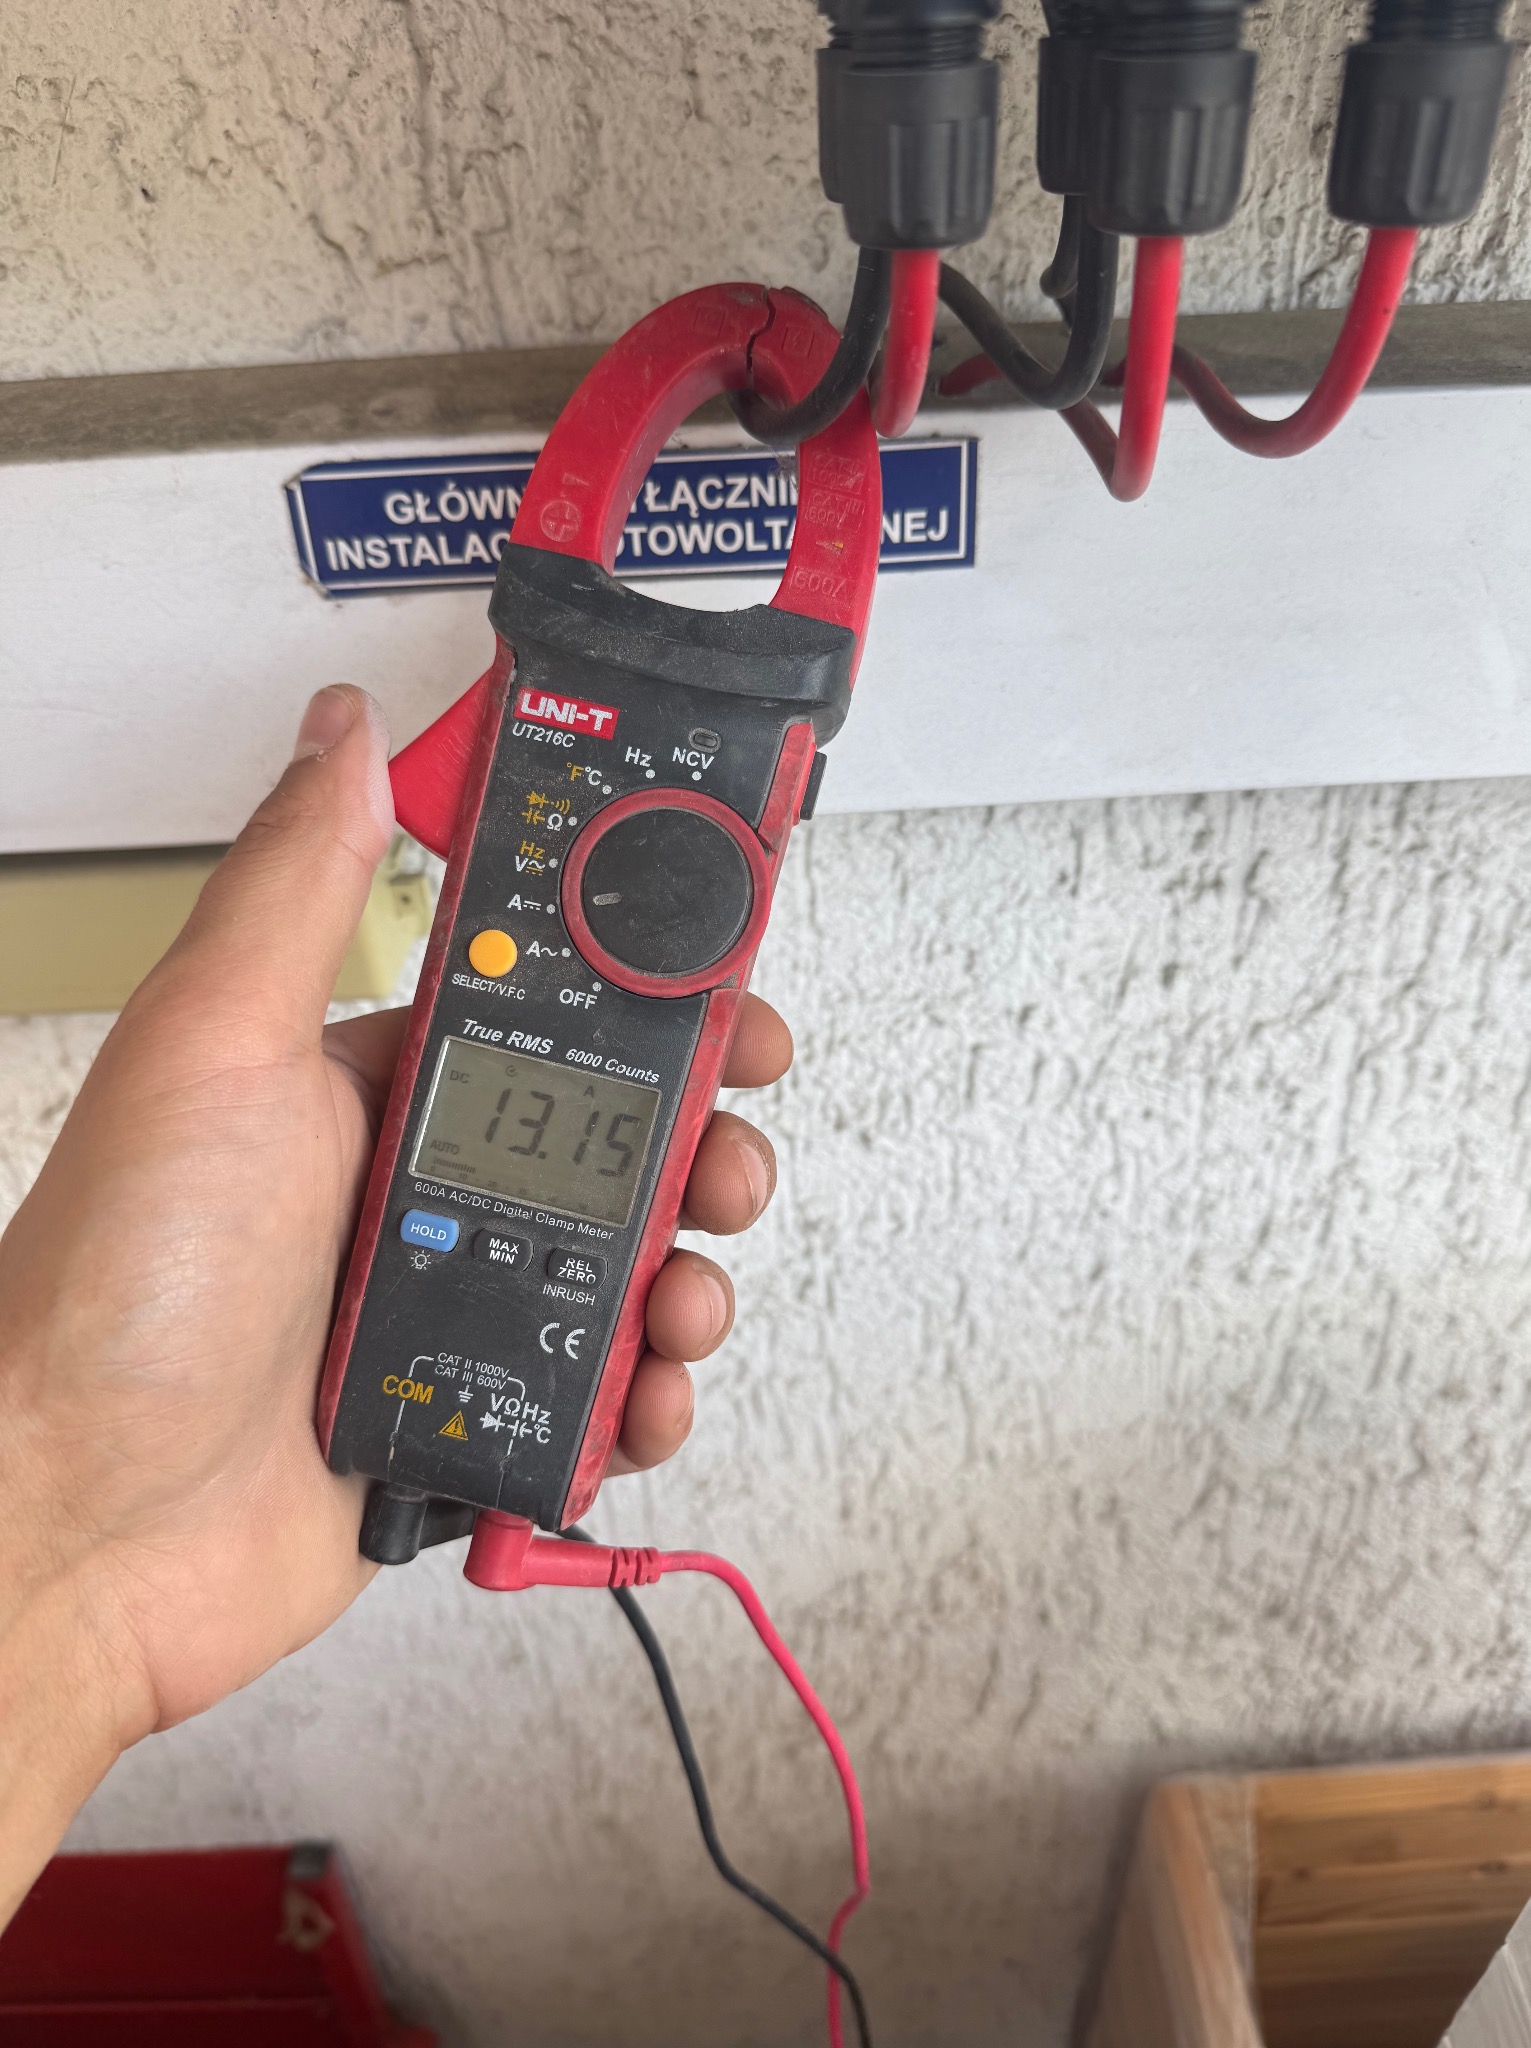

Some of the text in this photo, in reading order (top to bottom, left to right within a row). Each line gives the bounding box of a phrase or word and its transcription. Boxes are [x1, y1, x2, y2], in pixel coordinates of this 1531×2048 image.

[384, 473, 799, 525] GŁÓWN ŁĄCZNI
[325, 532, 511, 571] INSTALAC
[519, 692, 613, 733] UNI-T
[511, 722, 576, 749] UT216C
[624, 746, 652, 768] Hz
[671, 747, 715, 771] NCV
[519, 841, 546, 860] Hz
[451, 973, 526, 1001] SELECT/V.F.C
[559, 988, 598, 1010] OFF
[462, 1018, 554, 1055] True RMS
[449, 1069, 470, 1085] DC
[565, 1048, 660, 1084] 6000 Counts
[583, 1084, 596, 1098] A
[484, 1087, 643, 1178] 13.15
[430, 1138, 461, 1156] AUTO
[414, 1180, 447, 1199] 600A
[449, 1192, 493, 1211] AC/DC
[535, 1211, 576, 1234] Clamp
[577, 1221, 615, 1241] Meter
[410, 1222, 448, 1242] HOLD
[488, 1236, 520, 1255] MAX
[488, 1249, 516, 1266] MIN
[556, 1266, 597, 1285] ZERO
[565, 1256, 594, 1274] REL
[542, 1283, 597, 1306] INRUSH
[539, 1322, 586, 1360] CE
[434, 1363, 460, 1380] CAT
[476, 1374, 508, 1391] 600V
[437, 1351, 463, 1367] CAT
[474, 1360, 511, 1379] 1000V
[382, 1374, 435, 1405] COM
